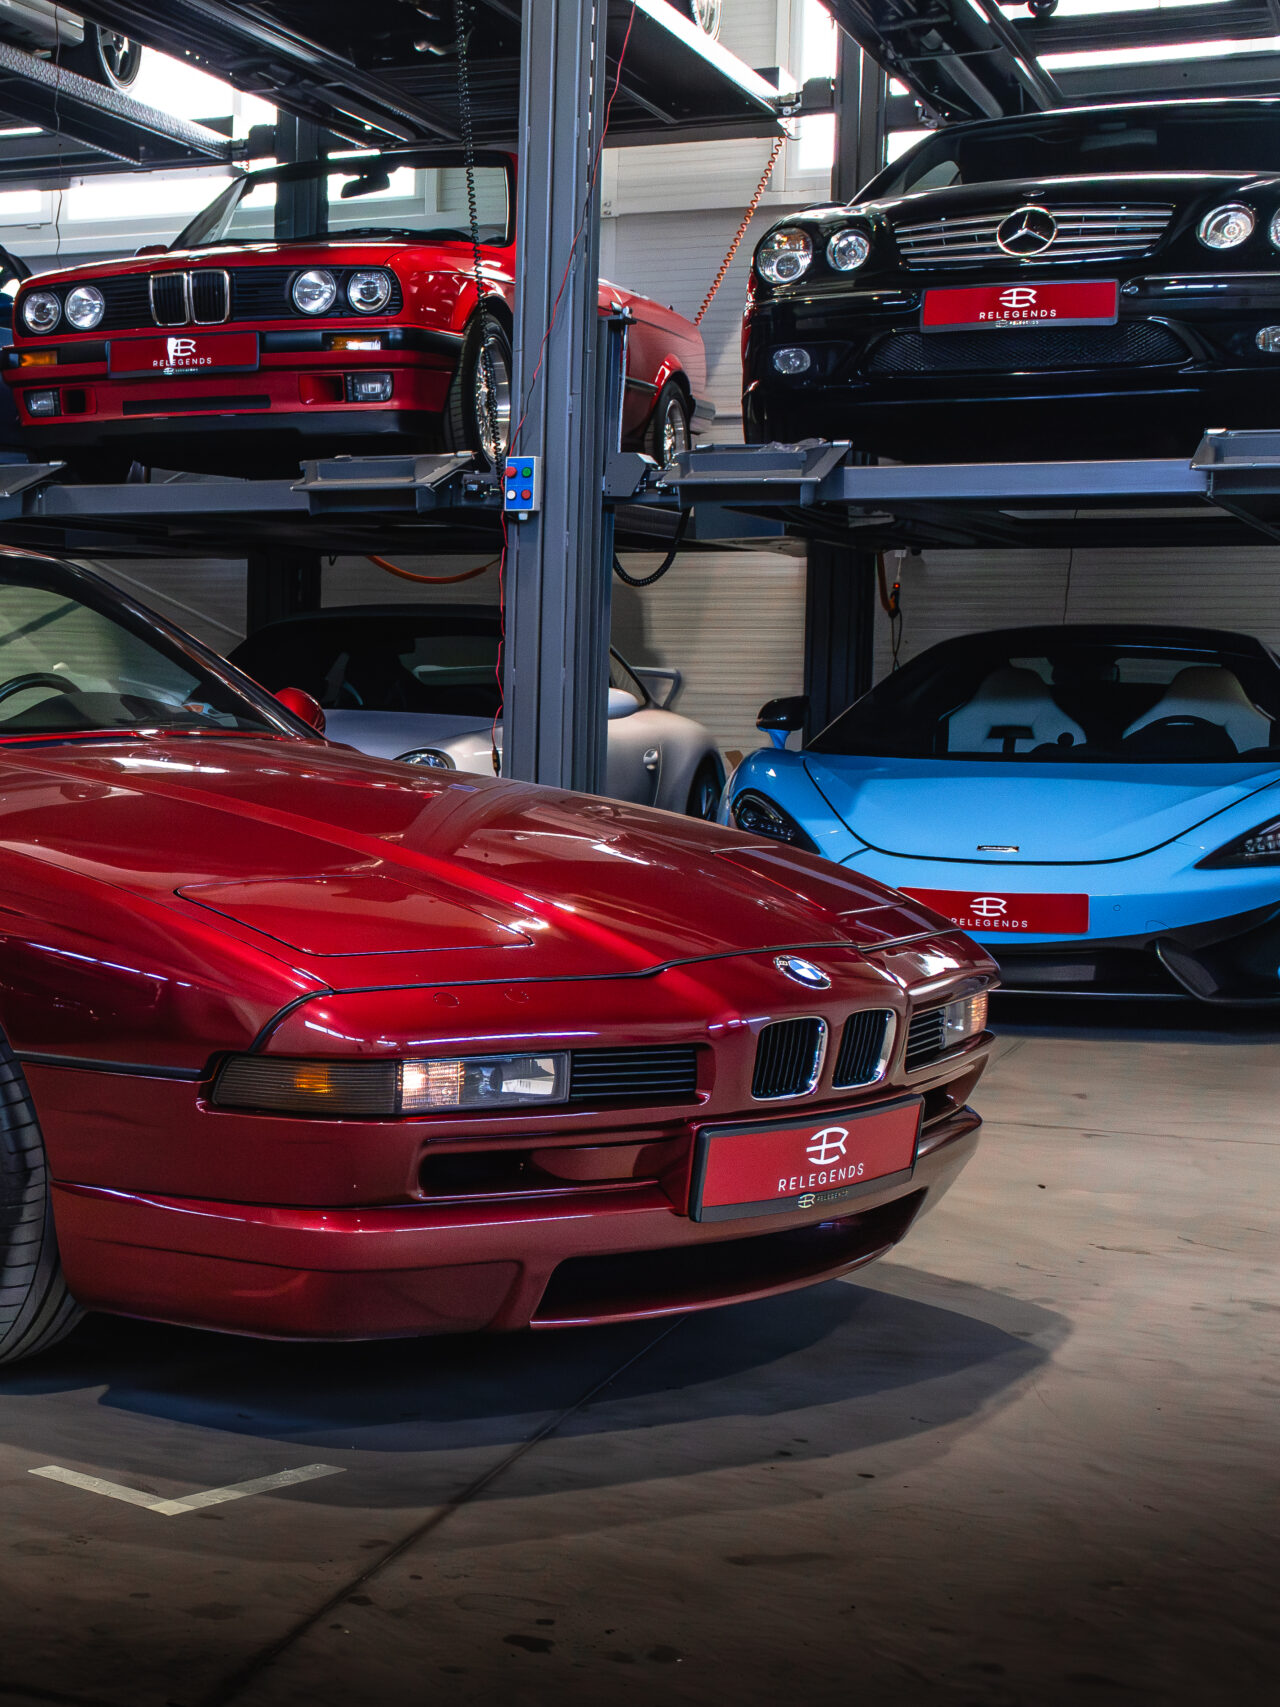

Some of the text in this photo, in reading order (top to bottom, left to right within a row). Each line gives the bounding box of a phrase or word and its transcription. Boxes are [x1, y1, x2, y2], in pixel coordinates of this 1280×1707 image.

[979, 309, 1057, 320] RELEGENDS
[152, 358, 212, 367] RELEGENDS
[778, 1162, 864, 1192] RELEGENDS
